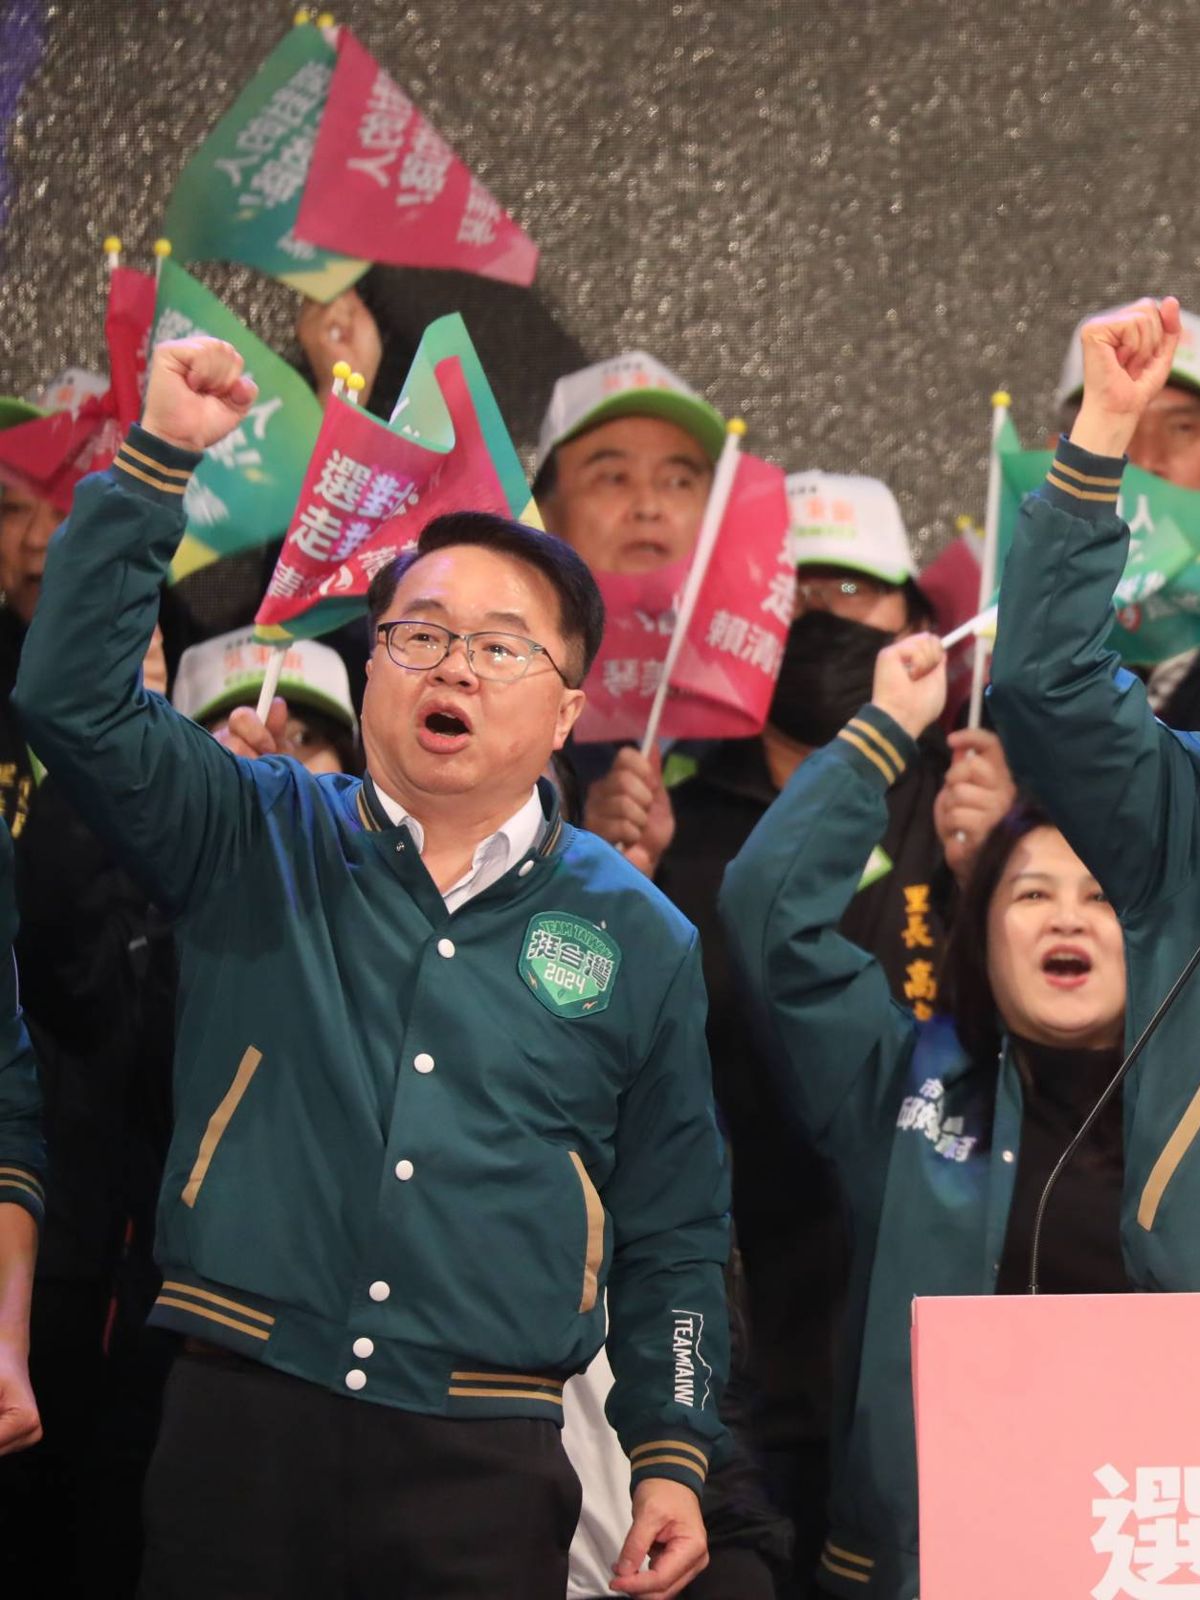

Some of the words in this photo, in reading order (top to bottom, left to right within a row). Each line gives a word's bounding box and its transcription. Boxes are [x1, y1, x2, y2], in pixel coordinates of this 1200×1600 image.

[526, 929, 616, 992] 挺台灣
[543, 962, 587, 995] 2024
